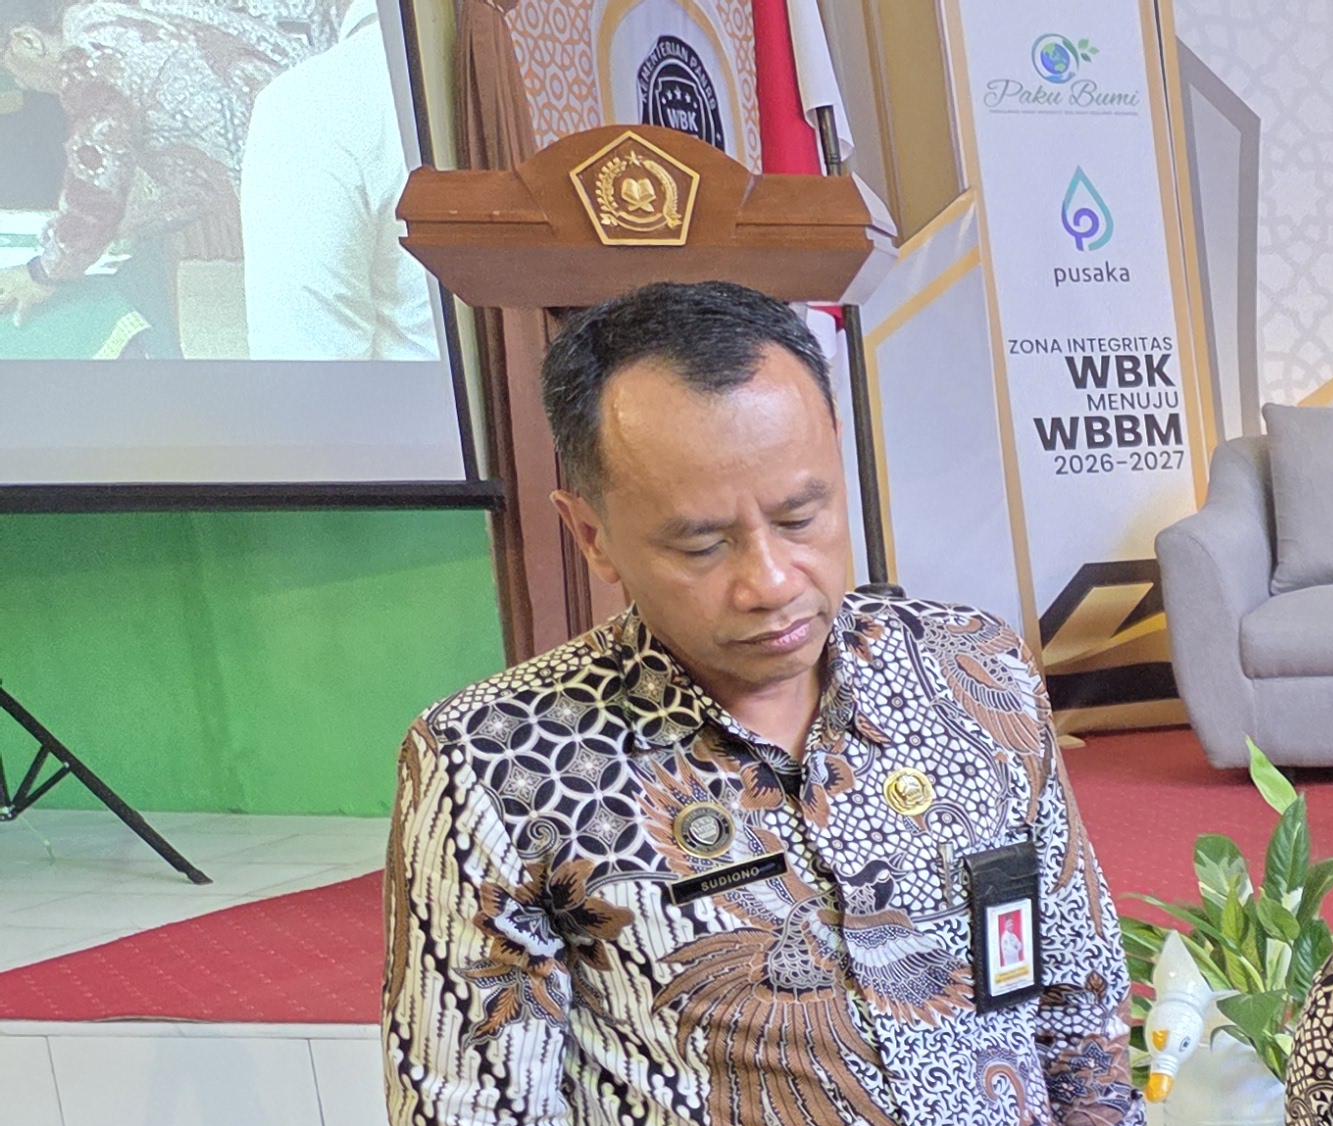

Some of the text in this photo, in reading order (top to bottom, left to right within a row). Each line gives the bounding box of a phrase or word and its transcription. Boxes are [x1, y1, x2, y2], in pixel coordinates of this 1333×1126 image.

[984, 79, 1140, 108] Paku Bumi
[667, 108, 698, 132] WBK
[1054, 261, 1130, 288] pusaka
[1008, 336, 1173, 355] ZONA INTEGRITAS
[1064, 354, 1176, 390] WBK
[1087, 391, 1179, 411] MENUJU
[1033, 413, 1183, 451] WBBM
[1055, 450, 1184, 475] 2026-2027
[701, 866, 760, 891] SUDIONO
